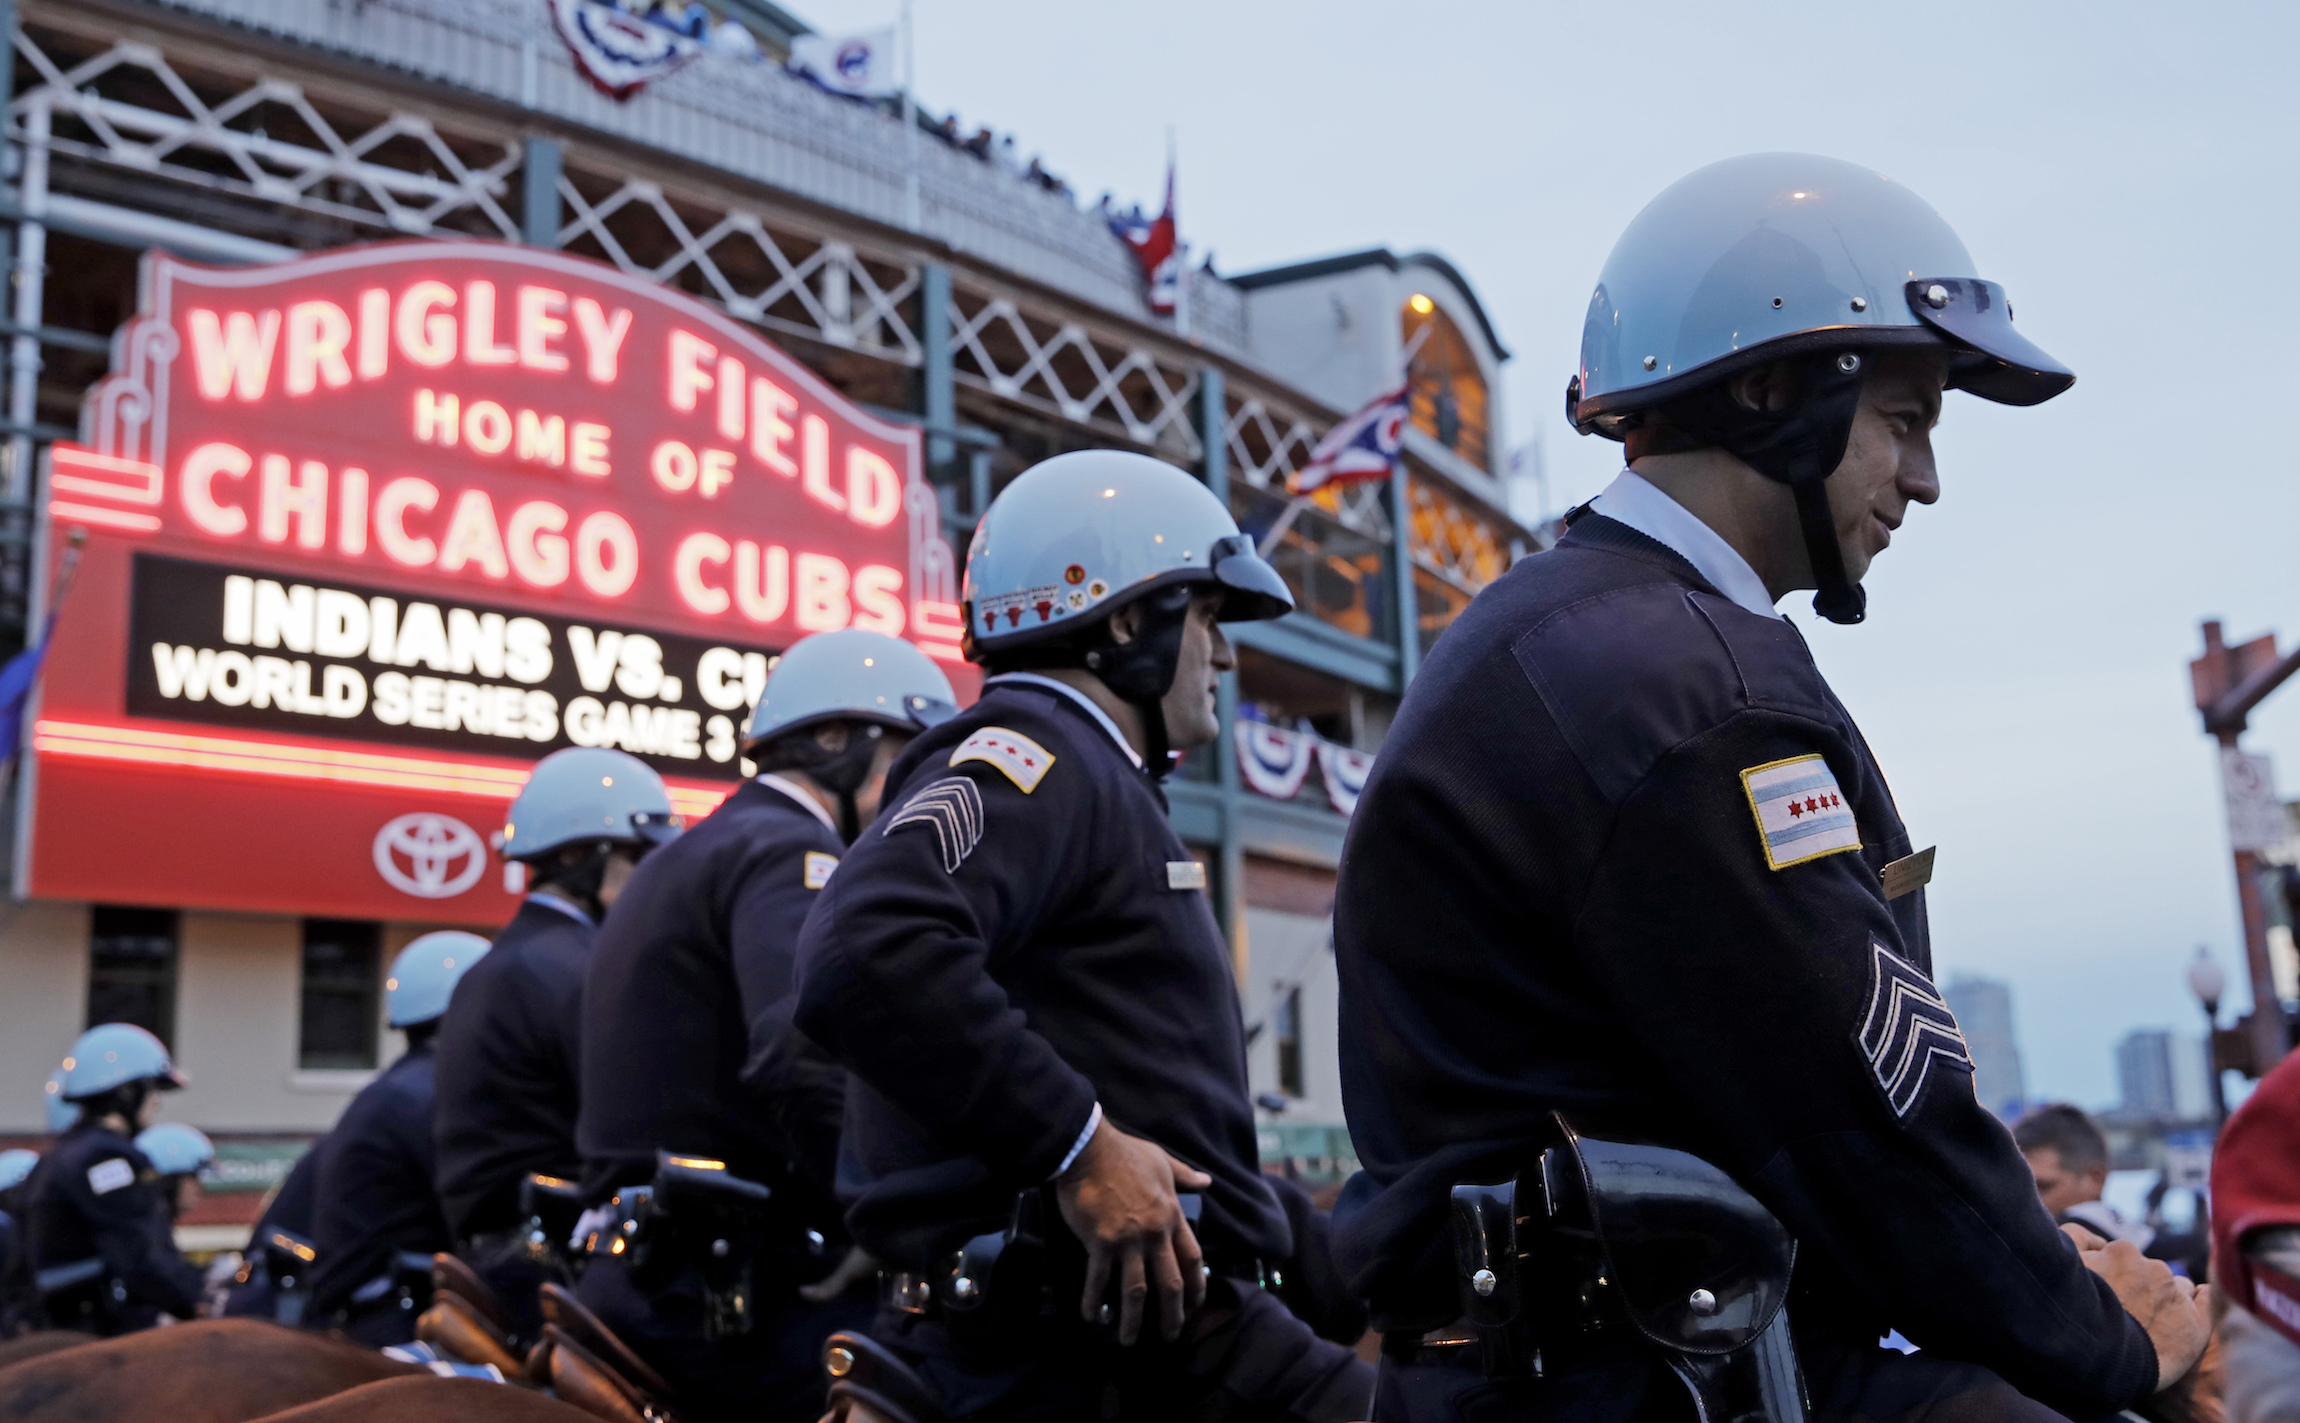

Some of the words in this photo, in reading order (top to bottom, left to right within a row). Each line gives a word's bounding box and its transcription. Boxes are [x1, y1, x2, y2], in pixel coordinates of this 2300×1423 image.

[189, 280, 632, 400] WRIGLEY
[669, 330, 901, 528] FIELD
[415, 388, 612, 475] HOME
[652, 441, 737, 497] OF
[181, 443, 638, 597] CHICAGO
[676, 533, 905, 638] CUBS
[223, 575, 553, 684] INDIANS
[566, 625, 683, 702] VS.
[151, 643, 368, 720] WORLD
[372, 672, 559, 743] SERIES
[564, 696, 701, 759] GAME
[704, 714, 737, 763] 3
